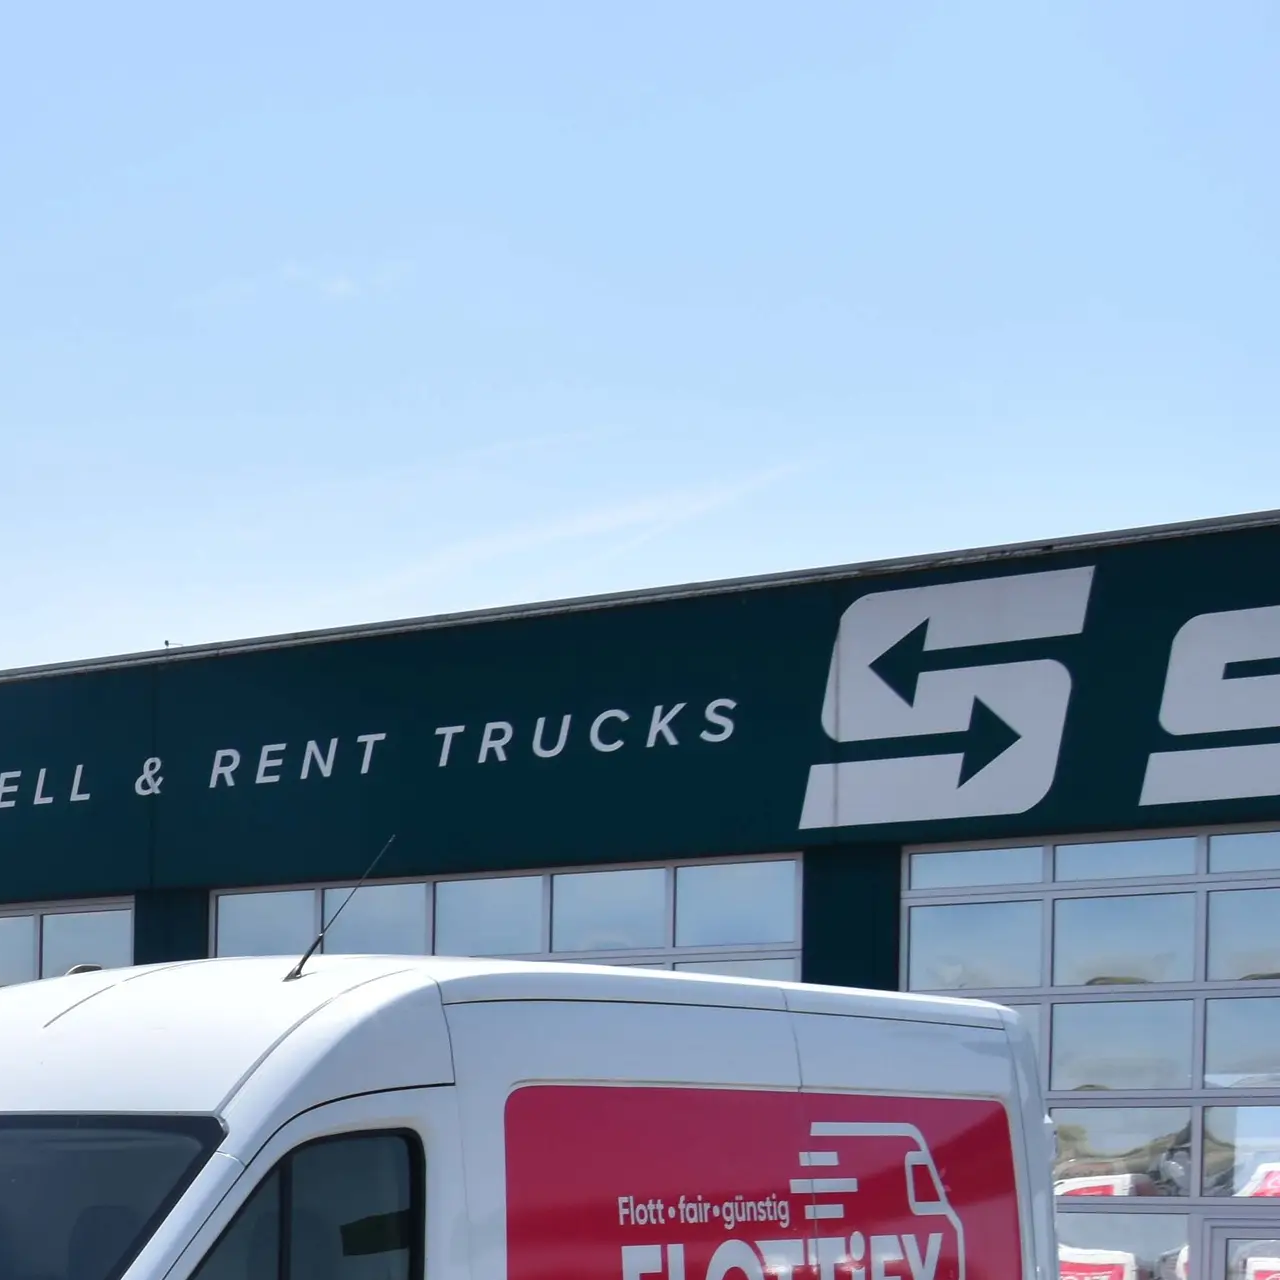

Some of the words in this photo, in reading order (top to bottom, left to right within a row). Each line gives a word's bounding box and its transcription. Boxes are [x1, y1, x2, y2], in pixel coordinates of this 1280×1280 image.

[134, 756, 164, 796] &
[208, 732, 386, 788] RENT
[433, 697, 738, 767] TRUCKS
